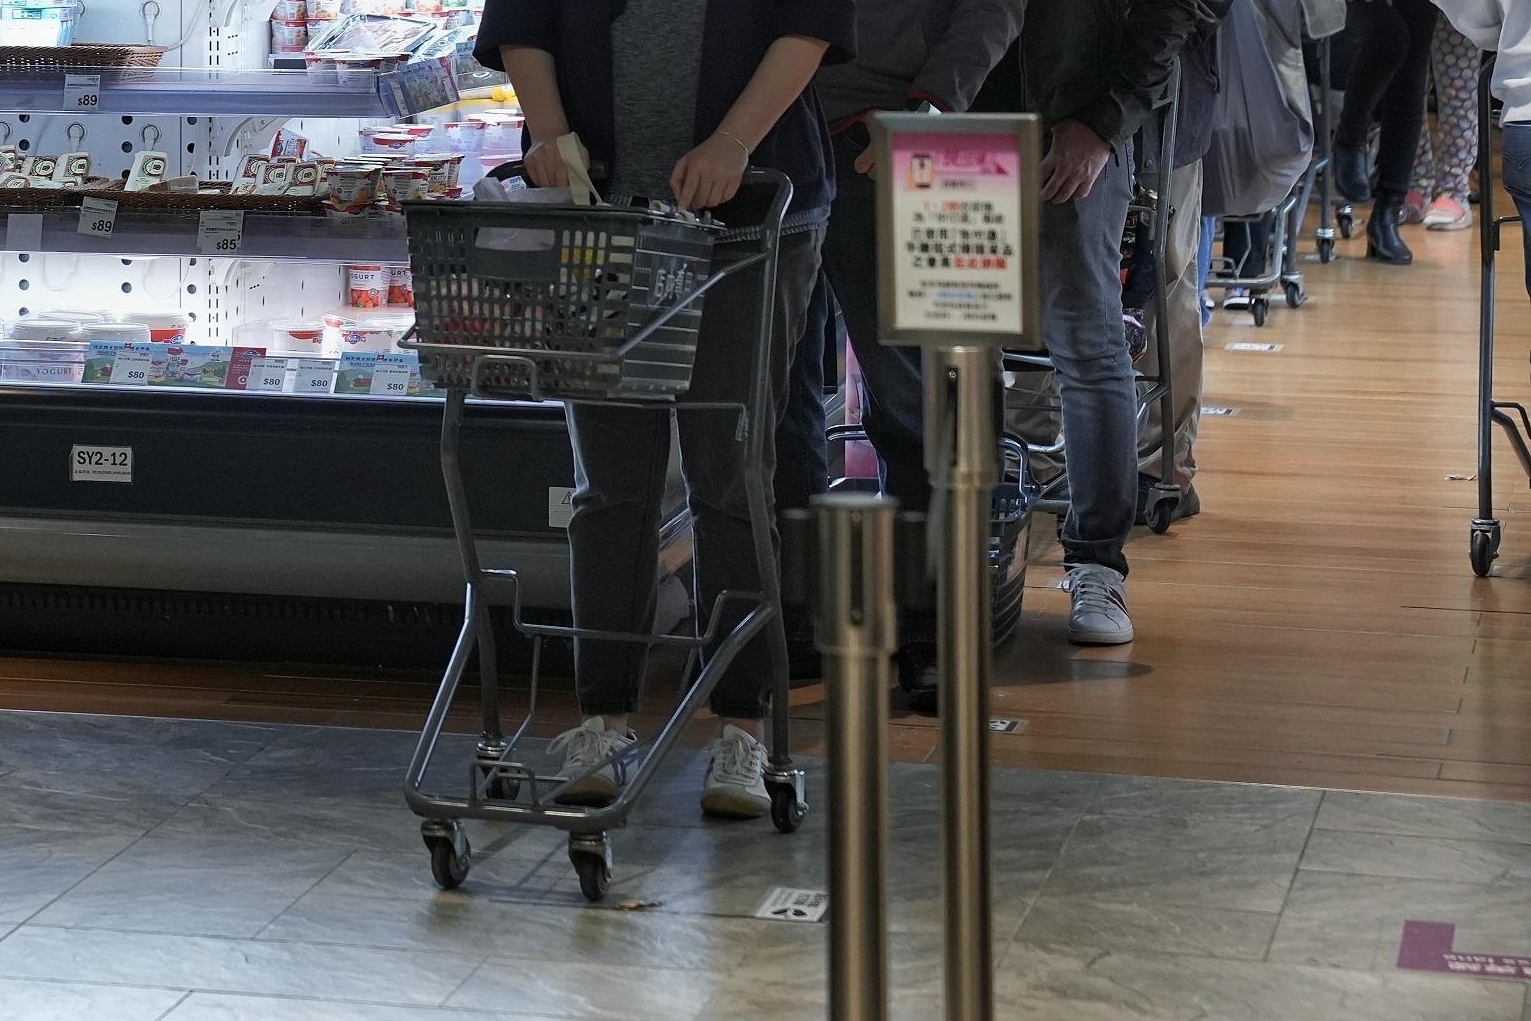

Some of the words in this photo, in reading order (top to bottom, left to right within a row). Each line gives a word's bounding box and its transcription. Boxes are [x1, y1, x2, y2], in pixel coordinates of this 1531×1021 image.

[77, 95, 97, 106] $89
[92, 220, 112, 233] $89
[216, 238, 237, 250] $85
[127, 370, 145, 379] $80
[263, 378, 281, 386] $80
[311, 379, 328, 387] $80
[387, 383, 404, 391] $80
[77, 451, 128, 466] SY2-12
